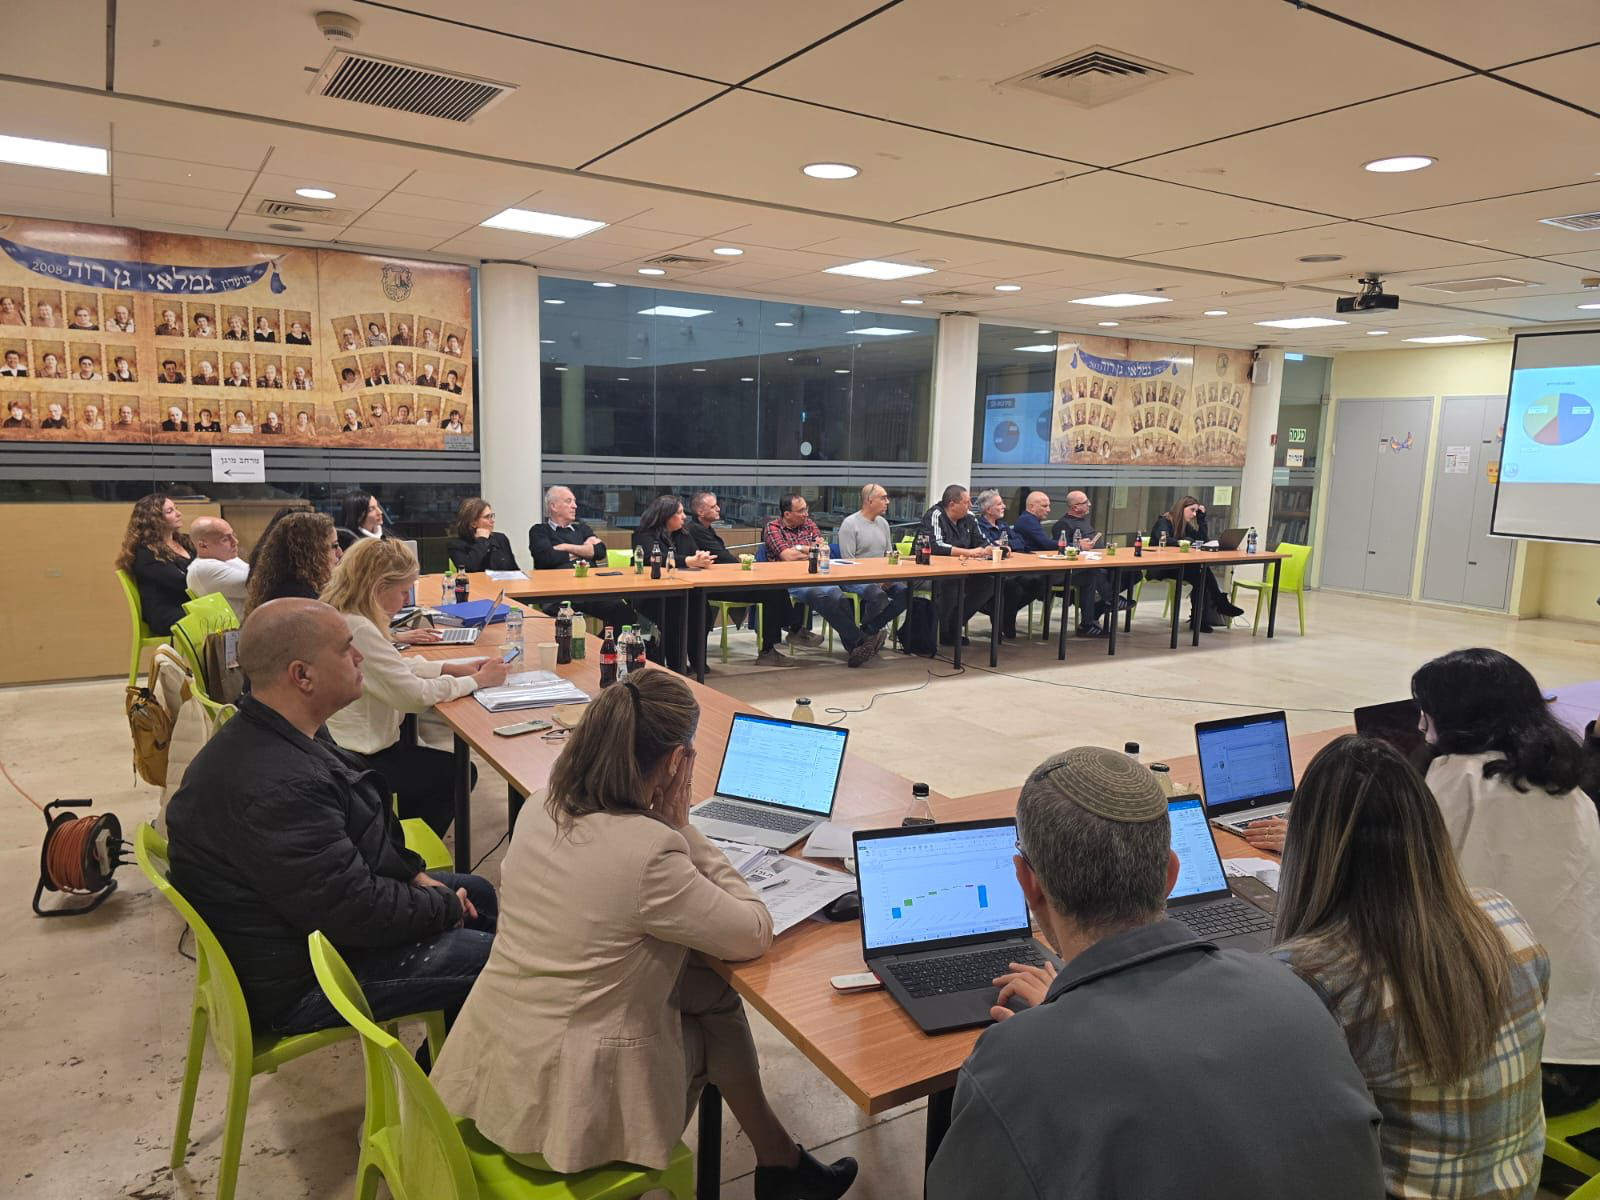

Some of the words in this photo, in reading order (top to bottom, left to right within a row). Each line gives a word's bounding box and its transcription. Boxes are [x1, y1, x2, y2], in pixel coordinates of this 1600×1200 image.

[31, 261, 63, 275] 2008
[68, 260, 105, 282] רוה
[113, 267, 131, 290] גן
[147, 266, 215, 290] גמלאי
[220, 275, 252, 290] מועדון
[1101, 361, 1115, 373] רוה
[1116, 363, 1124, 377] גן
[1127, 361, 1152, 376] גמלאי
[1289, 430, 1305, 440] כניסה
